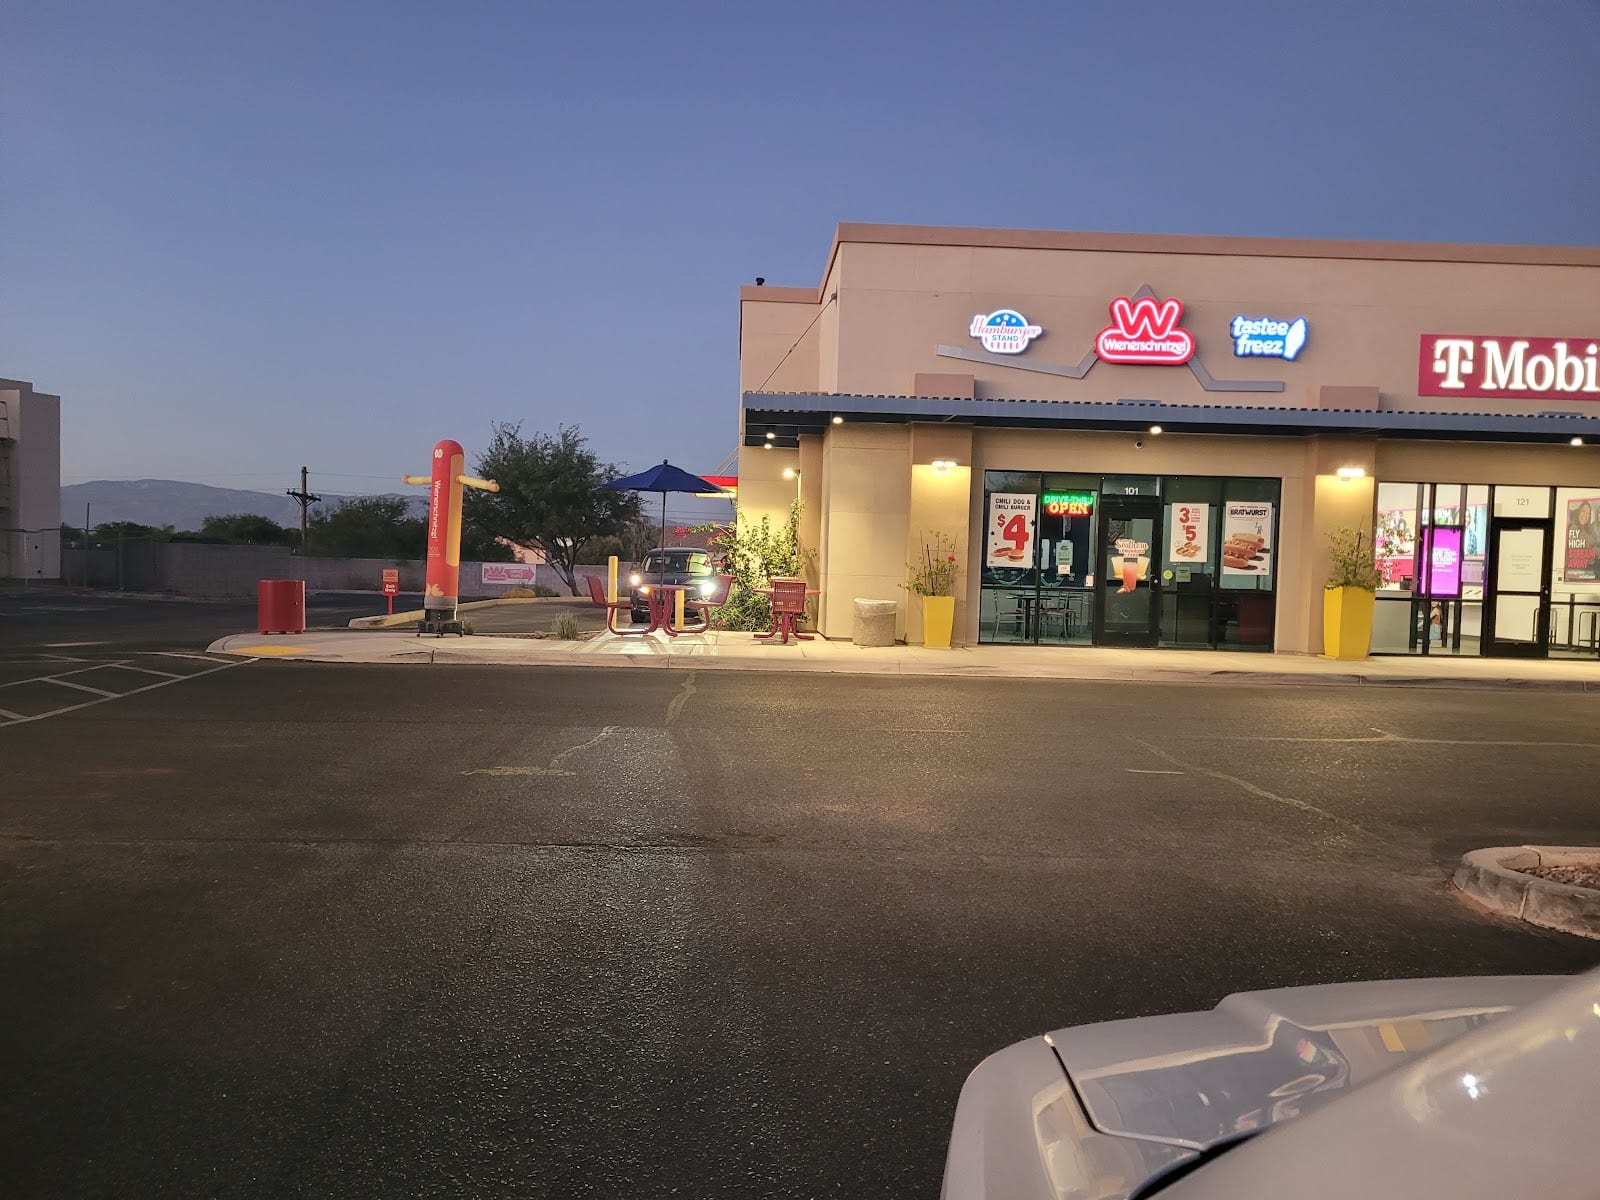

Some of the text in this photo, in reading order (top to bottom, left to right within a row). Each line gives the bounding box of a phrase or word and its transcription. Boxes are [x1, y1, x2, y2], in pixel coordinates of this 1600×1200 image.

[1114, 300, 1179, 339] W
[971, 317, 1039, 346] Hamburger
[1233, 316, 1289, 336] tastee
[1104, 338, 1186, 355] Wienerschnitzel
[1237, 334, 1284, 355] freez
[1124, 487, 1139, 495] 101
[1044, 495, 1093, 504] DRIVE-THRU
[1517, 498, 1529, 506] 121
[431, 480, 441, 539] Wienerschnitzel
[1049, 502, 1088, 514] OPEN
[1180, 508, 1190, 523] 3
[1569, 529, 1581, 538] FLY
[1569, 539, 1586, 548] HIGH
[1568, 549, 1596, 558] STREAM
[1568, 560, 1588, 568] AWAY
